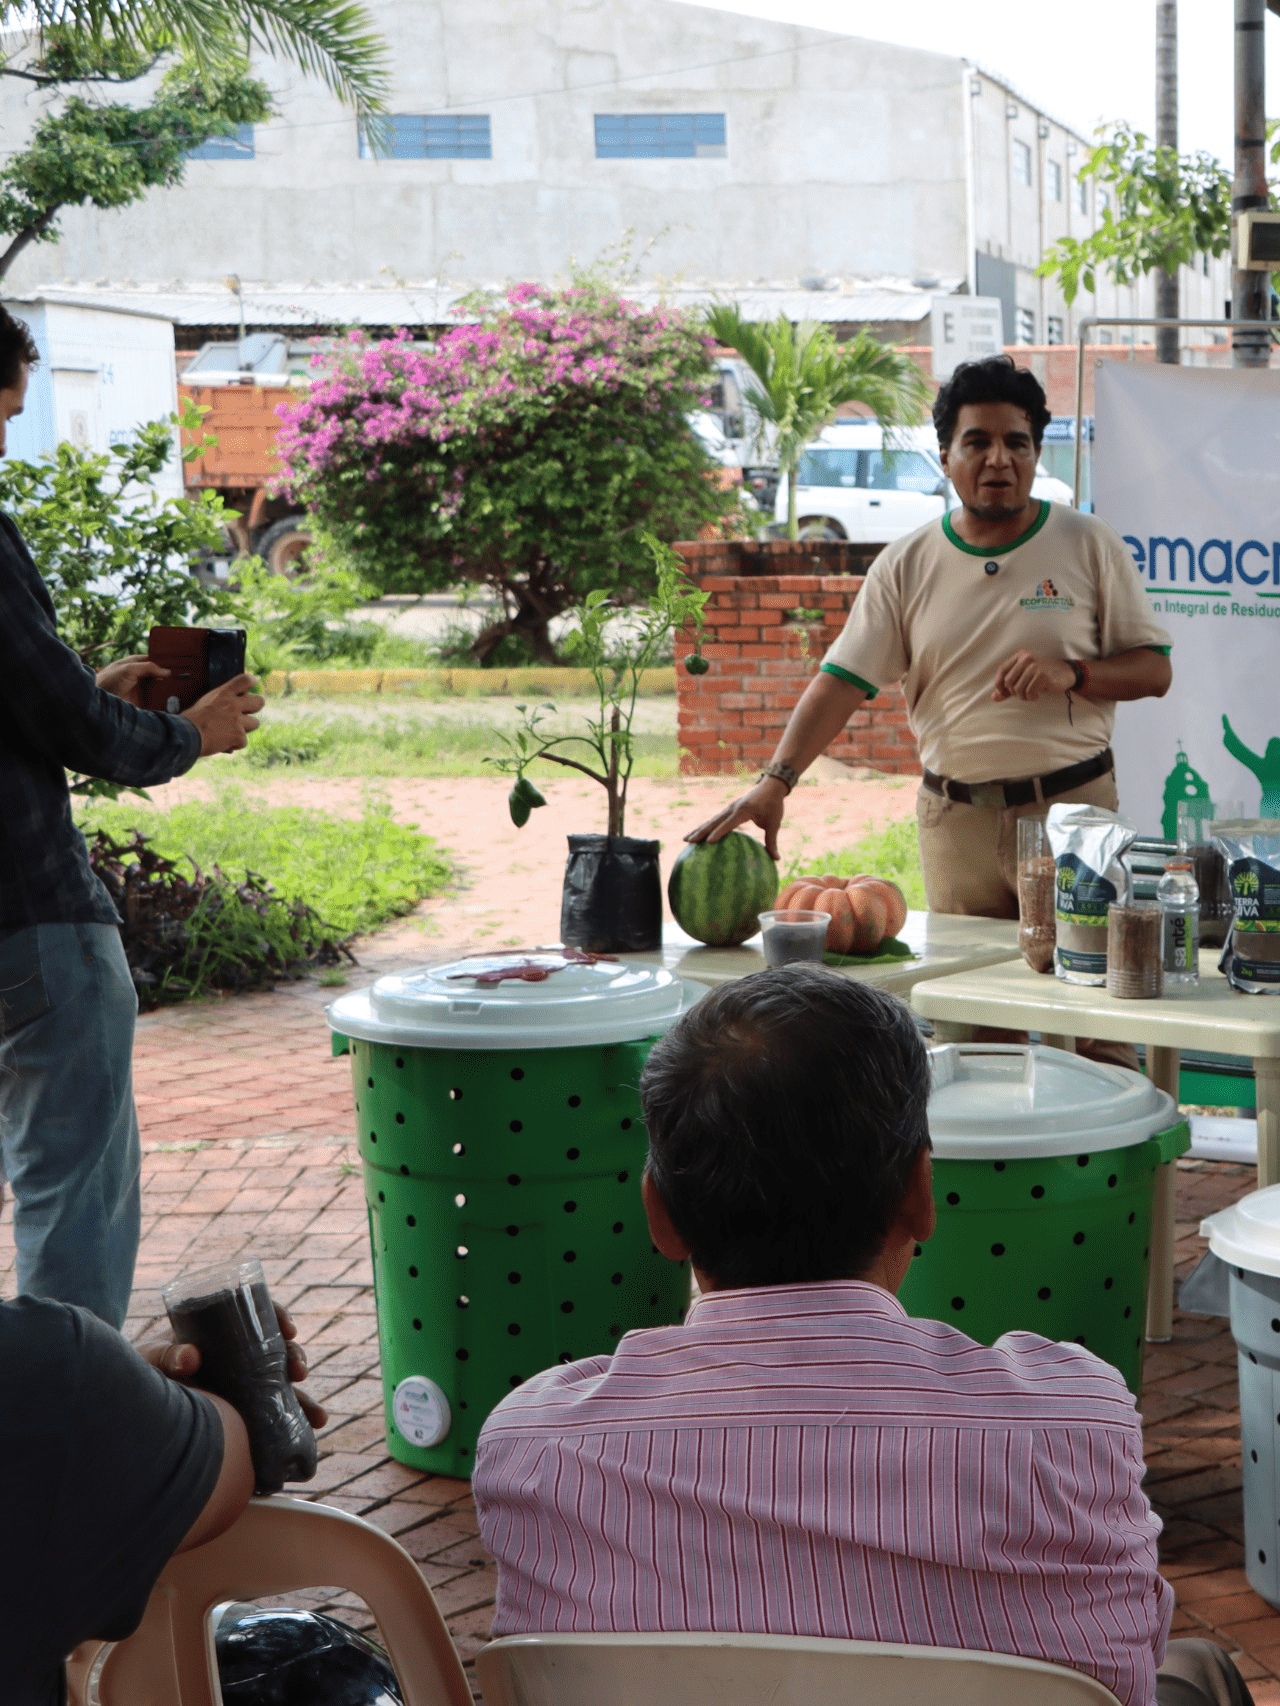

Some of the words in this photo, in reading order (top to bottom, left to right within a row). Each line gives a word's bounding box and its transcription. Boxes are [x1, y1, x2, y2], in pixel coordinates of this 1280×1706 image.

[1165, 600, 1209, 617] Integral
[1212, 602, 1228, 616] de
[1234, 897, 1259, 906] TERRA
[1170, 917, 1187, 968] santé
